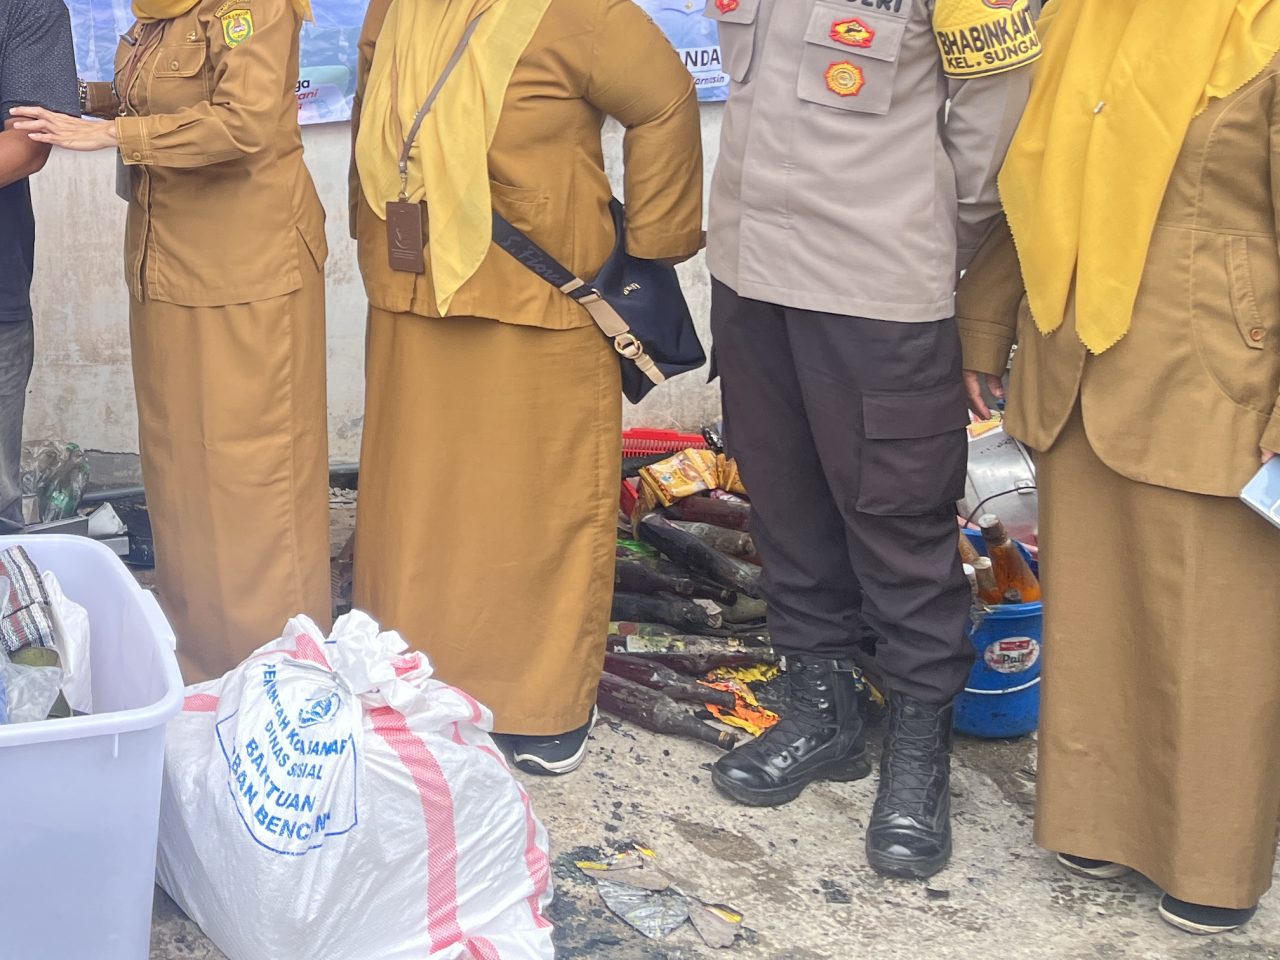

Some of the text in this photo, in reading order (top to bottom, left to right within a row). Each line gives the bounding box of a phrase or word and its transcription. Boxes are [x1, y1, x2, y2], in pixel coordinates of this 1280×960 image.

[685, 48, 721, 67] NDA
[265, 720, 290, 767] DINAS
[245, 737, 316, 813] BANTUAN
